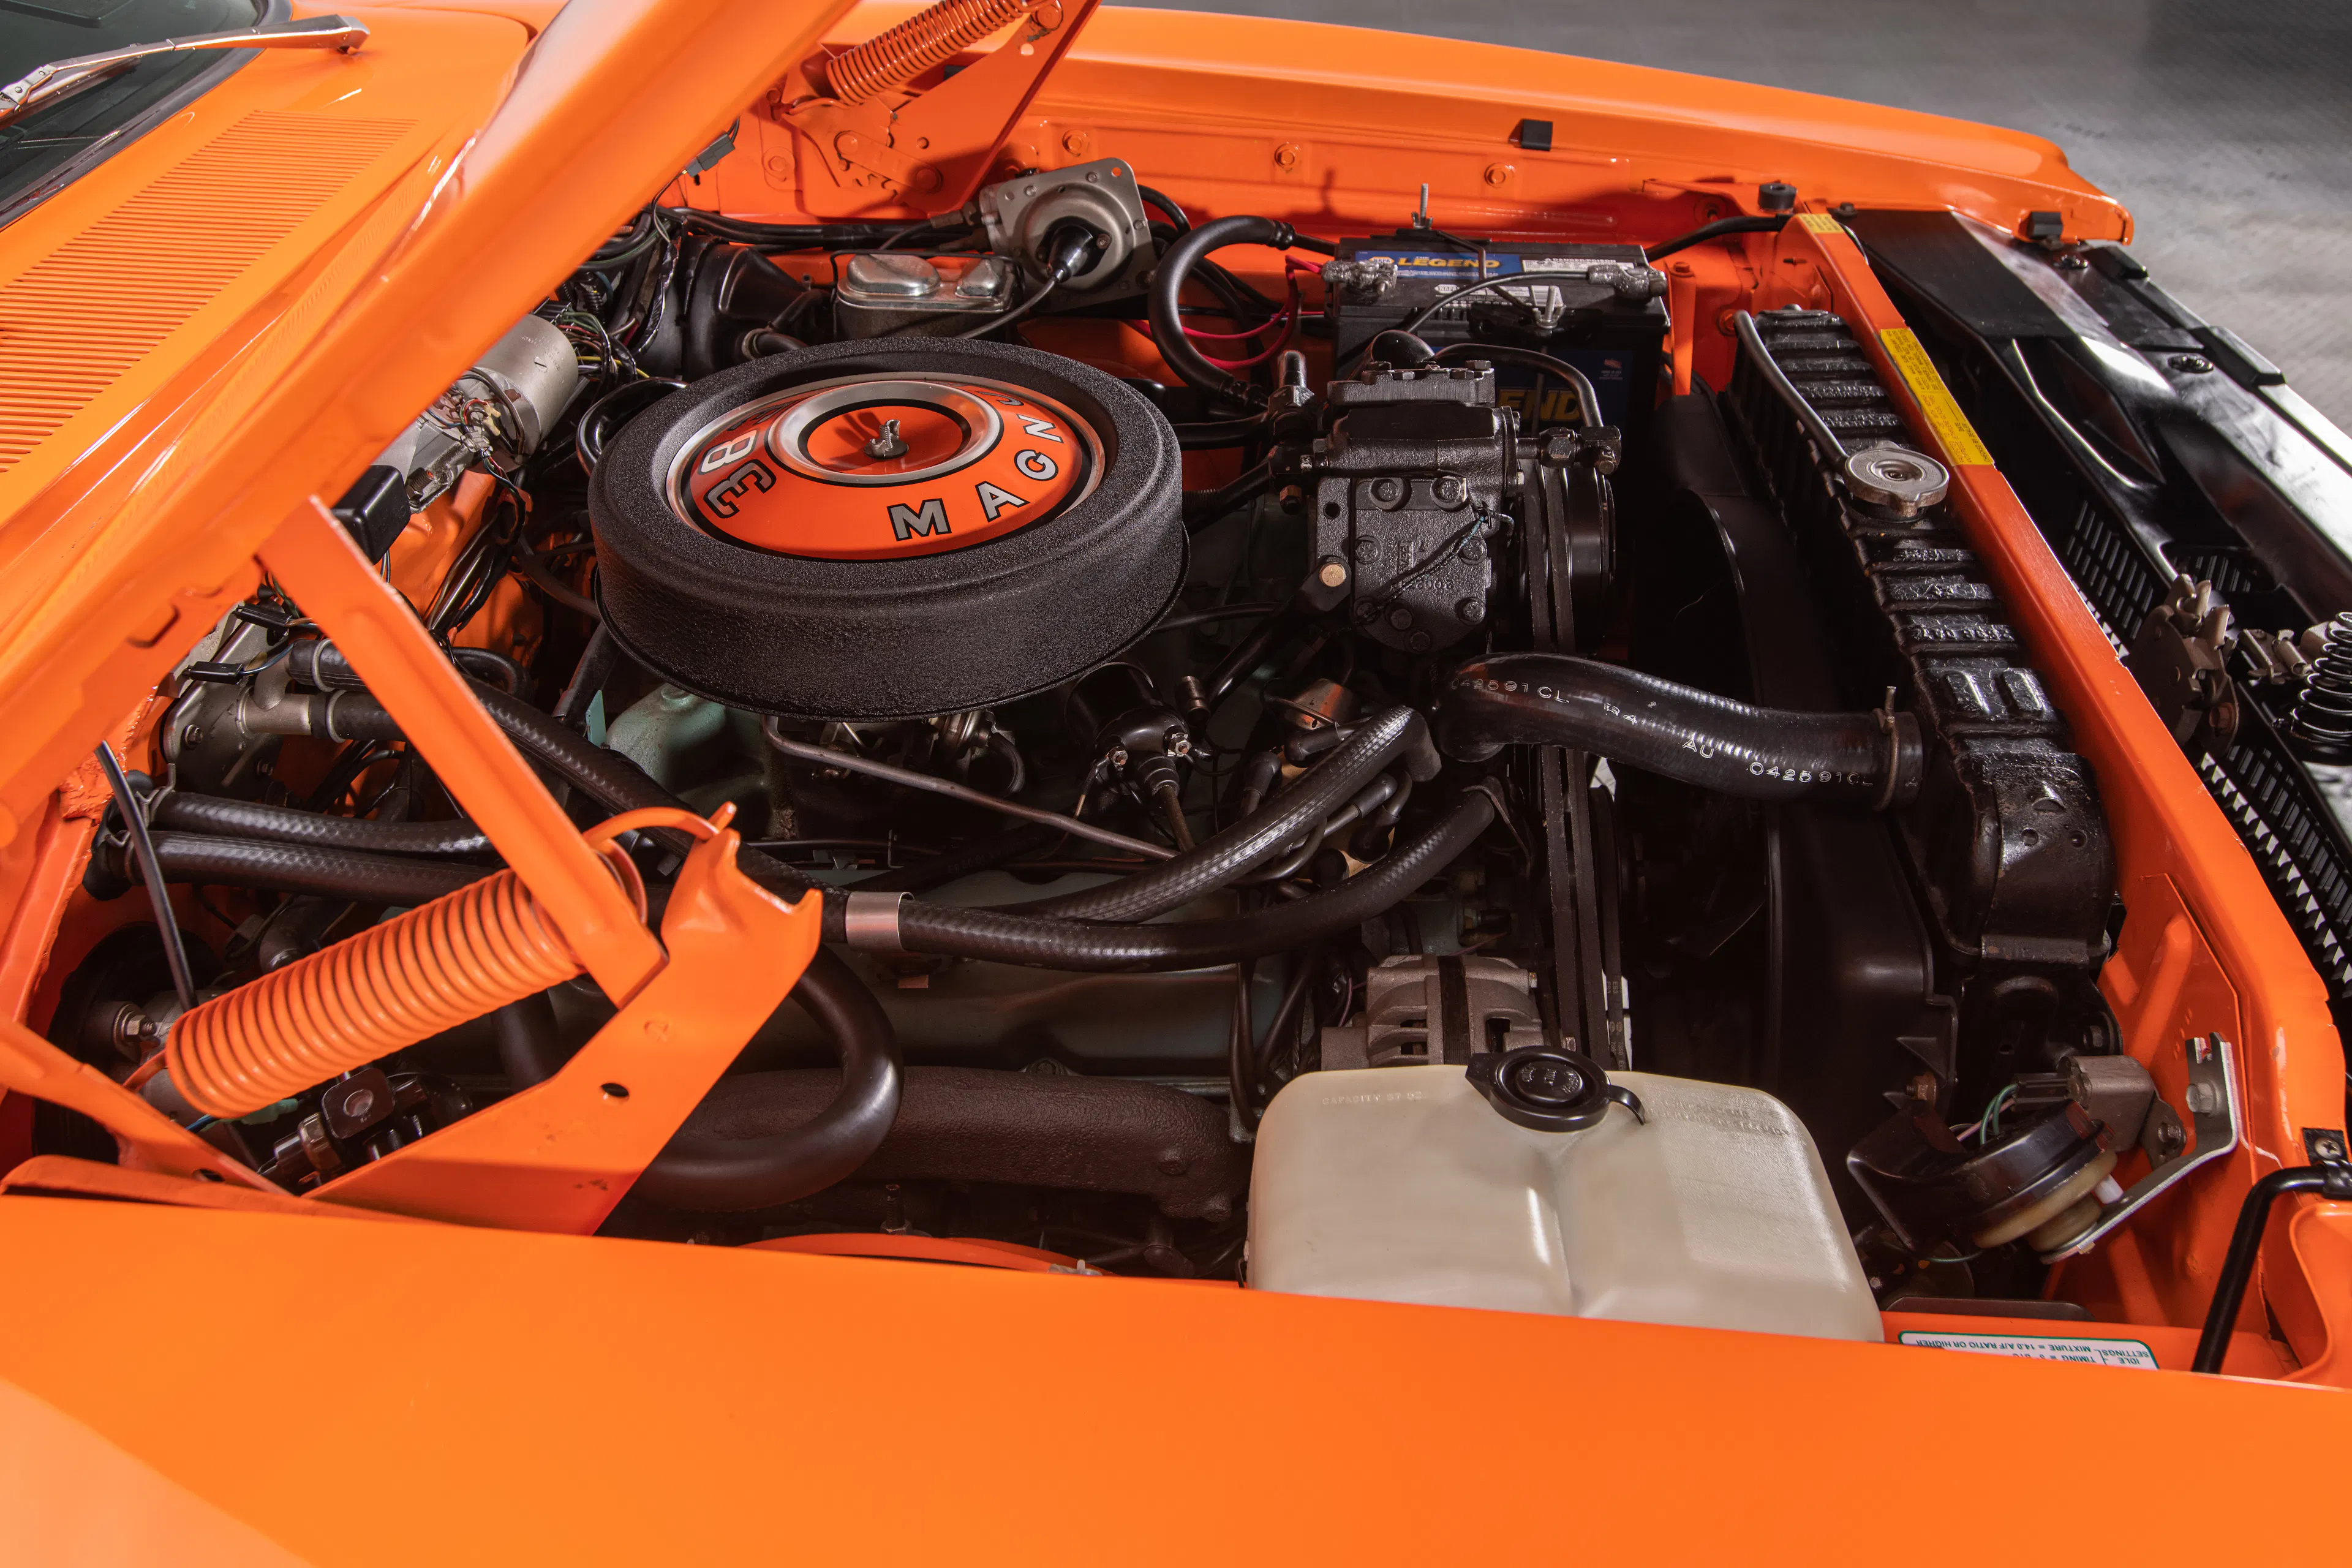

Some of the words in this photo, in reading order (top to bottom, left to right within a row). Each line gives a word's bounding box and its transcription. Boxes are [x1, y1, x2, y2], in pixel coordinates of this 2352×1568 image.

[1398, 257, 1500, 268] LEGEND
[1683, 739, 1714, 758] AU
[1915, 1339, 1952, 1349] HIGHER
[2048, 1344, 2091, 1353] MIXTURE
[2062, 1354, 2097, 1363] TIMING
[2103, 1348, 2150, 1359] SETTINGS
[2119, 1356, 2141, 1365] IDLE
